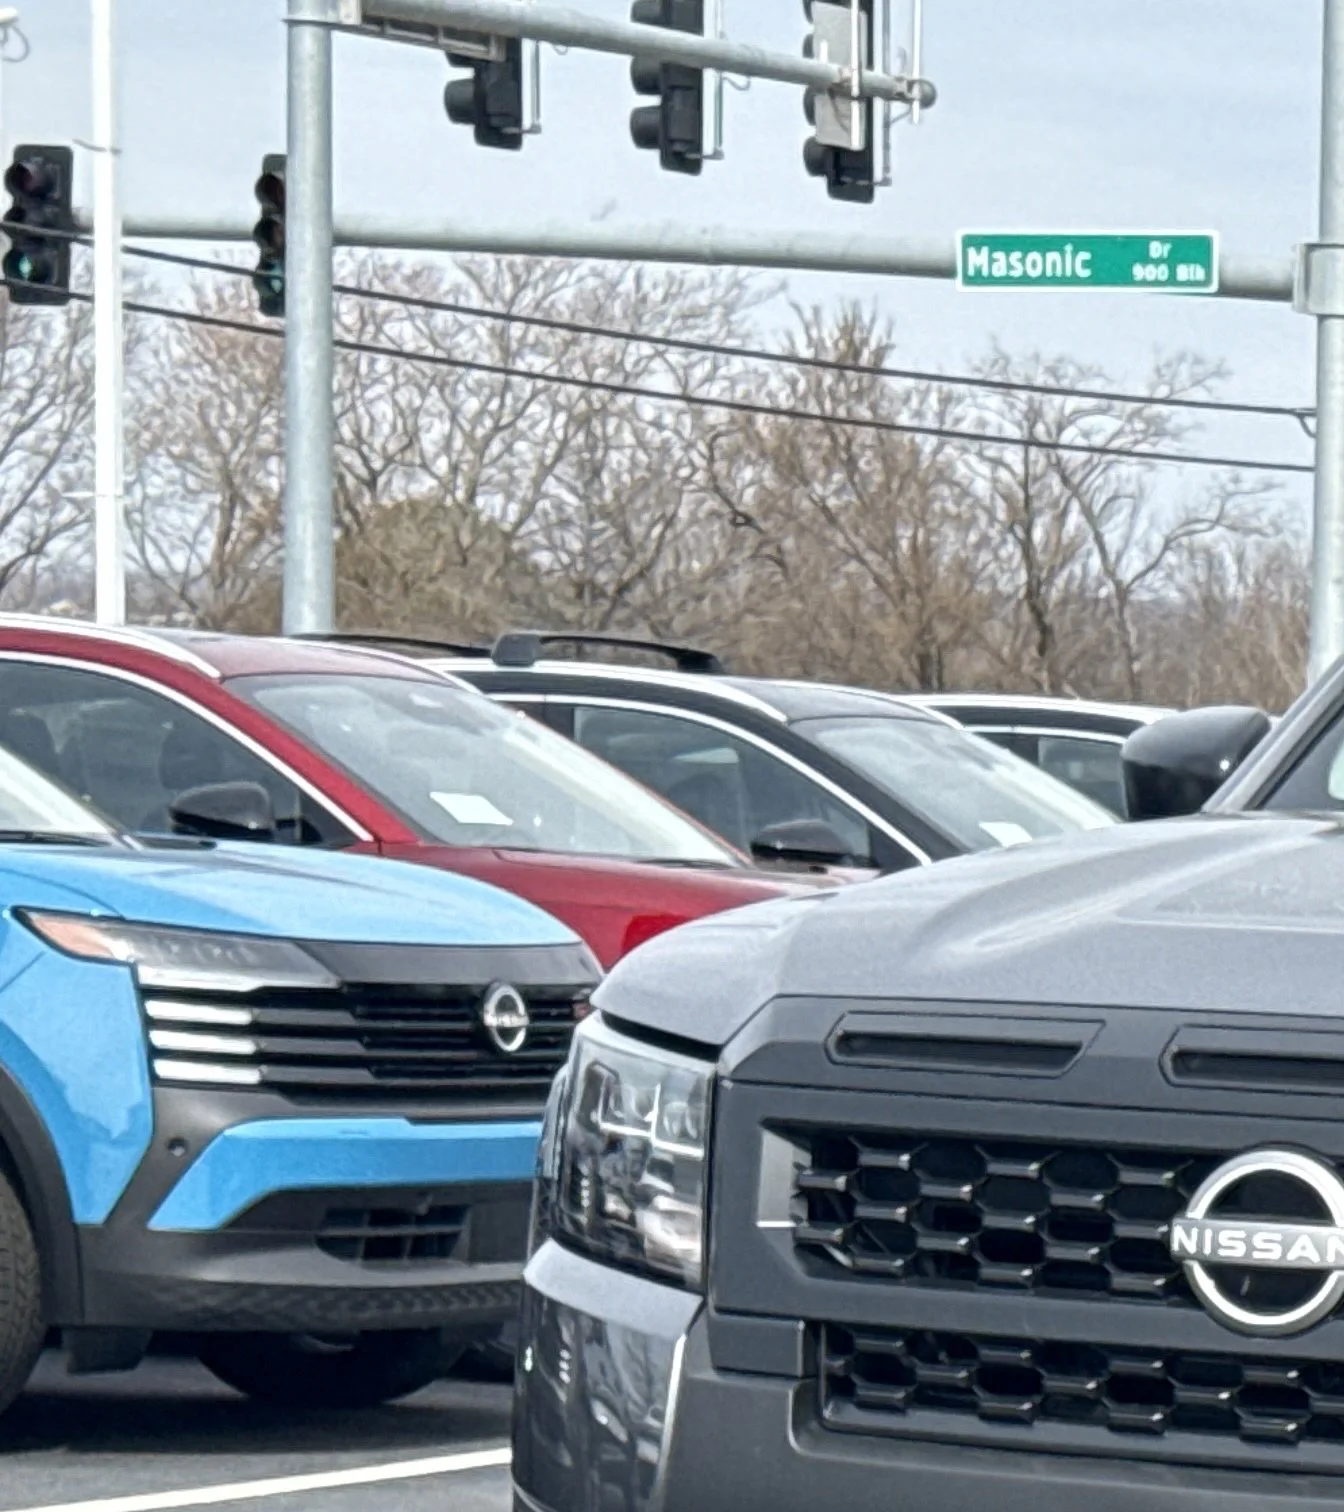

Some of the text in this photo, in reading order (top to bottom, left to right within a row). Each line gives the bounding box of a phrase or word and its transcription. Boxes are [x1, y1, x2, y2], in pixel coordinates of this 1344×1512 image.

[1149, 240, 1172, 258] Dr
[967, 244, 1092, 278] Masonic
[1132, 263, 1168, 282] 900
